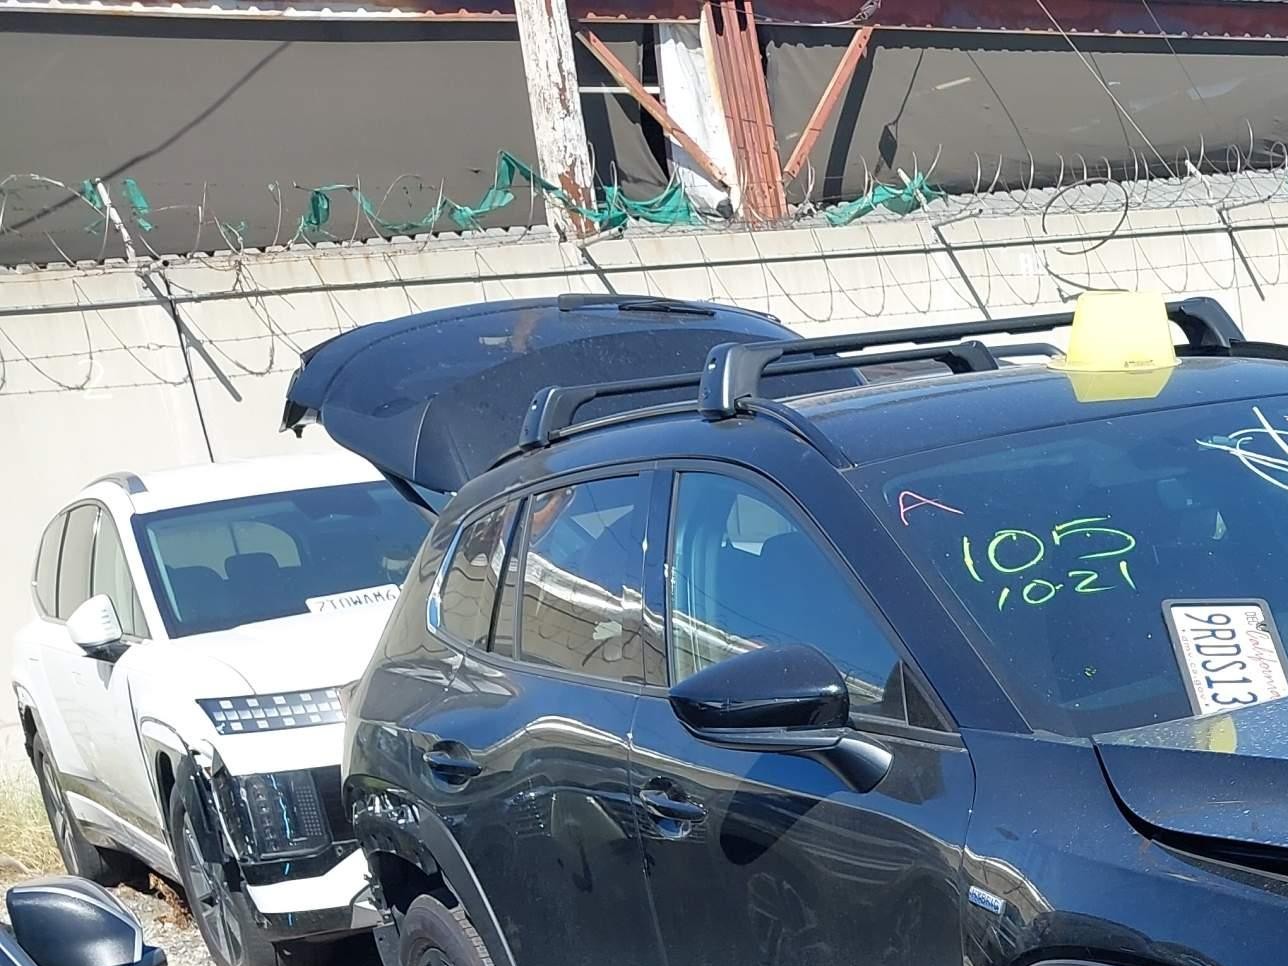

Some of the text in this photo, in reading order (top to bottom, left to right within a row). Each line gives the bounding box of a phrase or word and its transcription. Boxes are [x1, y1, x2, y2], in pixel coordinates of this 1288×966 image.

[899, 491, 964, 526] A
[963, 517, 1136, 583] 105
[1184, 613, 1259, 711] 9RDS13
[1246, 630, 1281, 699] California
